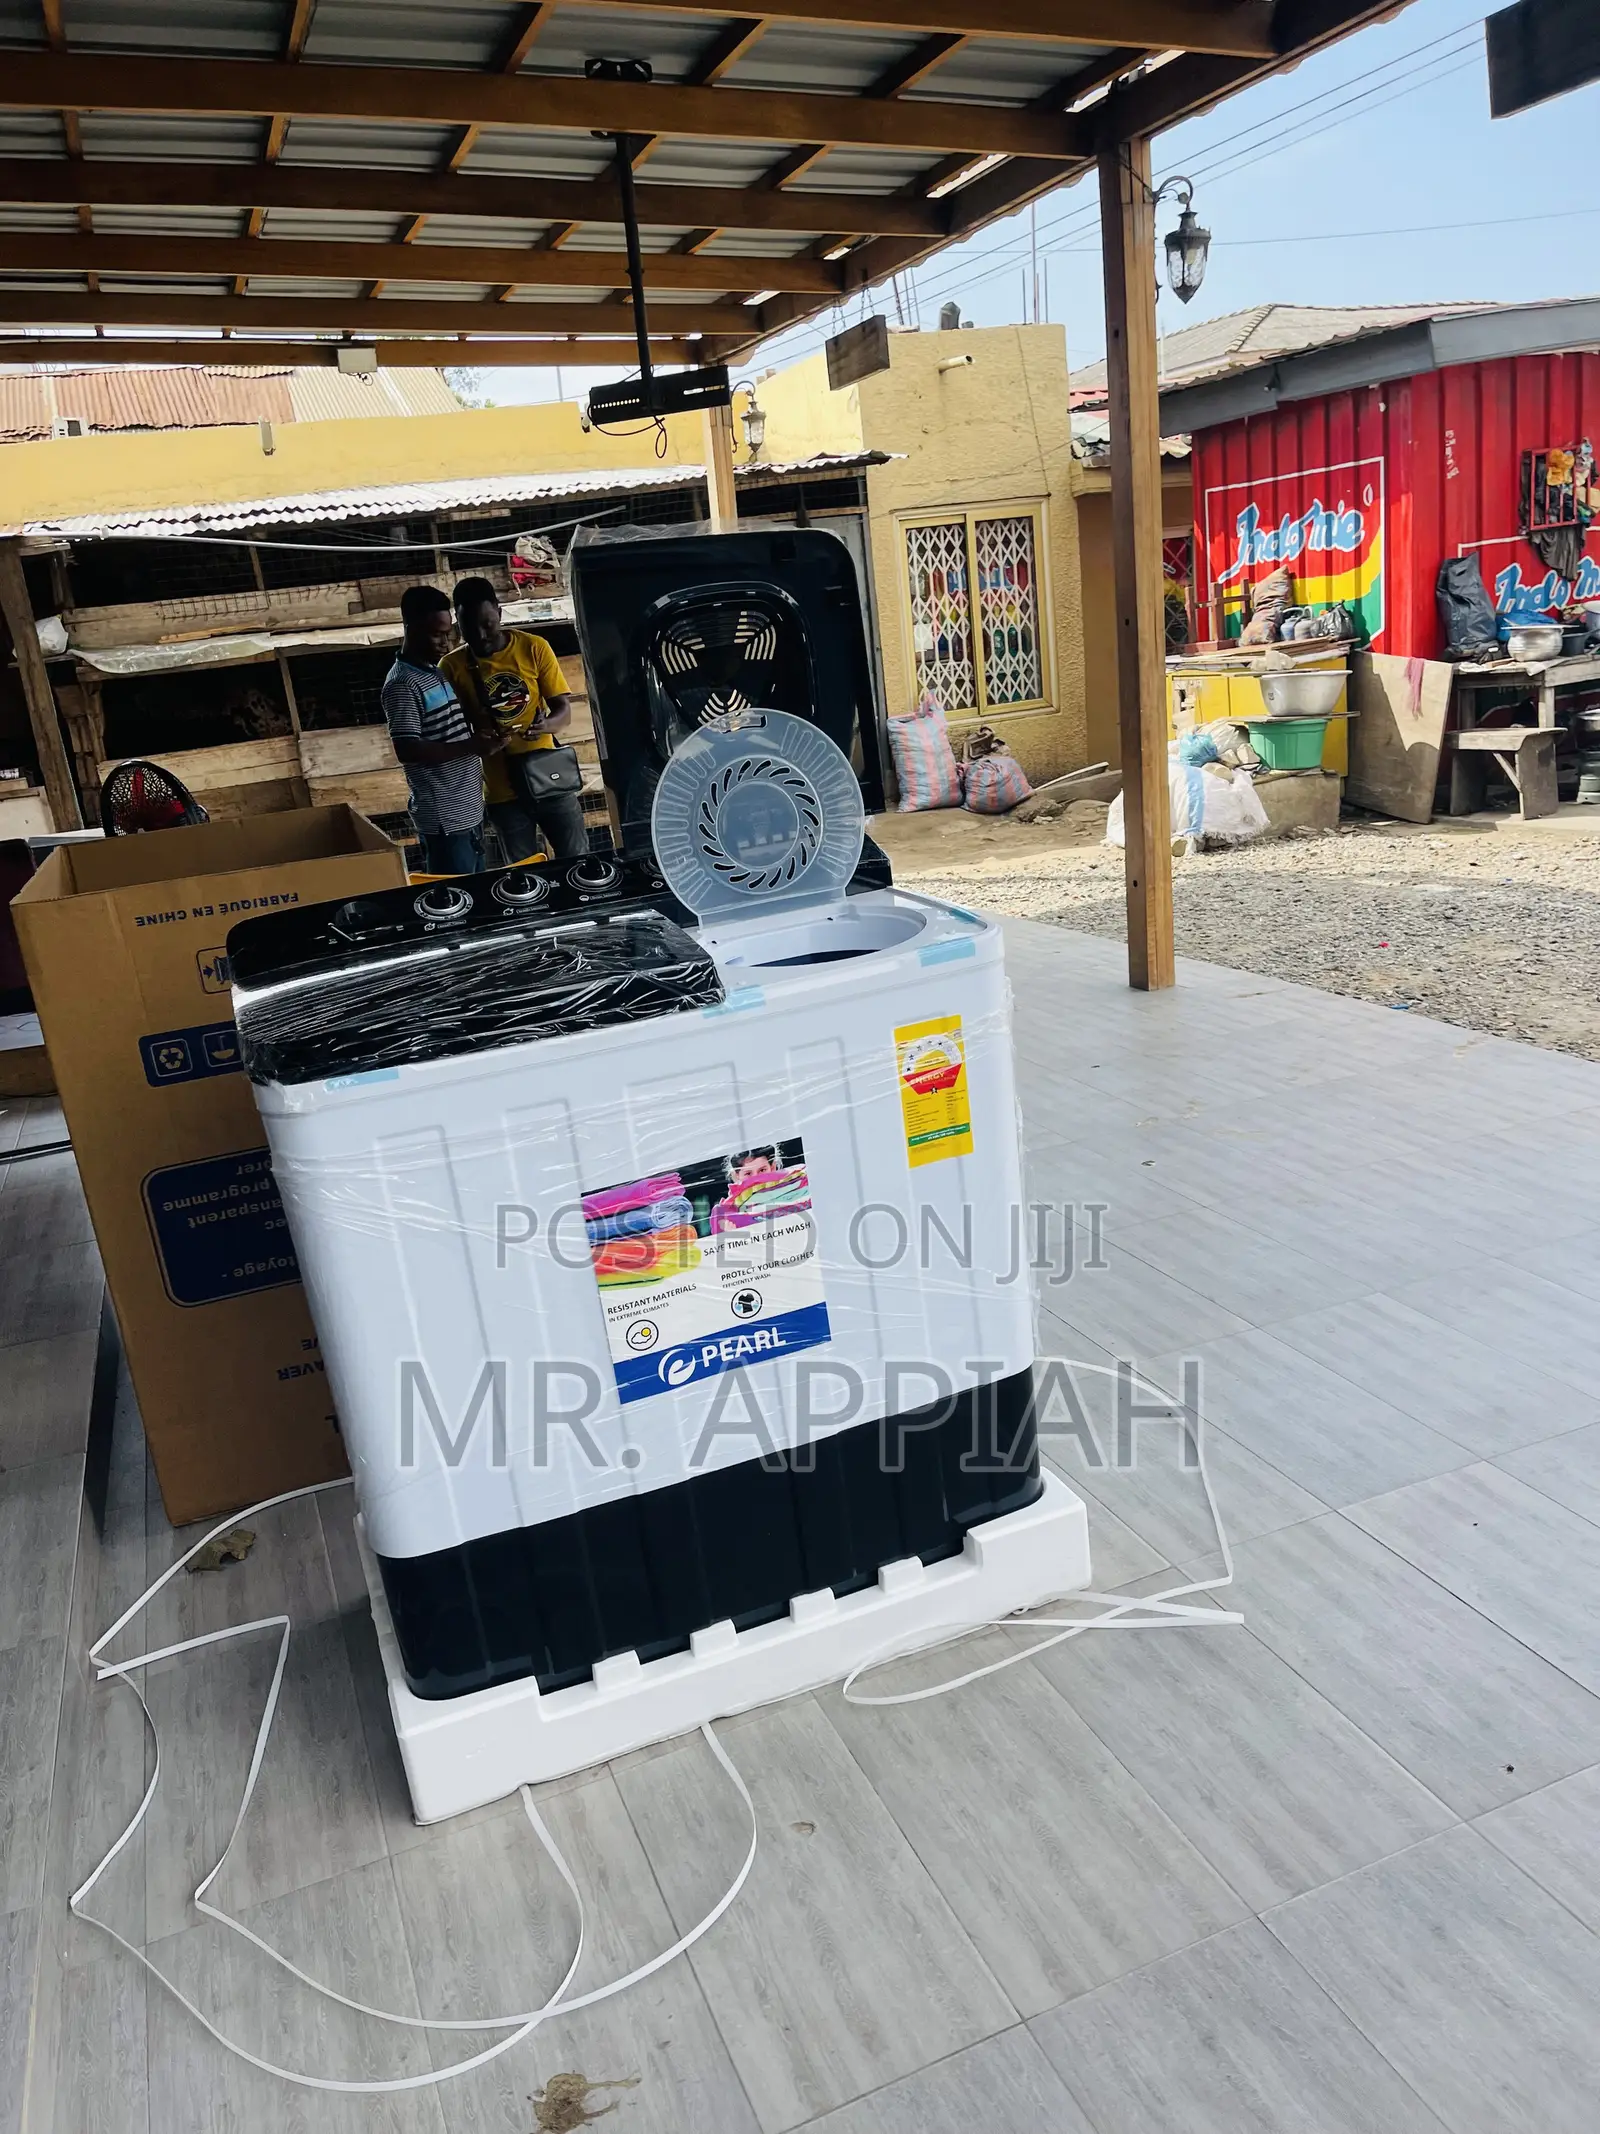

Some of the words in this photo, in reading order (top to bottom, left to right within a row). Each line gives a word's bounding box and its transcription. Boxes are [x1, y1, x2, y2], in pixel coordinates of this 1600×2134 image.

[192, 905, 214, 918] EN
[219, 892, 299, 915] FABRIQUÉ
[135, 910, 187, 927] CHINE
[162, 1178, 271, 1211] programme
[187, 1198, 283, 1228] ansparent
[703, 1243, 725, 1257] SAVE
[727, 1239, 749, 1250] TIME
[750, 1235, 760, 1244] IN
[762, 1229, 784, 1241] EACH
[785, 1221, 812, 1235] WASH
[233, 1256, 298, 1278] toyage
[720, 1266, 756, 1282] PROTECT
[757, 1260, 780, 1272] YOUR
[781, 1250, 815, 1266] CLOTHES
[607, 1297, 651, 1315] RESISTANT
[652, 1283, 697, 1302] MATERIALS
[616, 1308, 642, 1321] EXTREME
[642, 1302, 670, 1314] CLIMATES
[701, 1327, 787, 1368] PEARL
[276, 1360, 325, 1381] AVER
